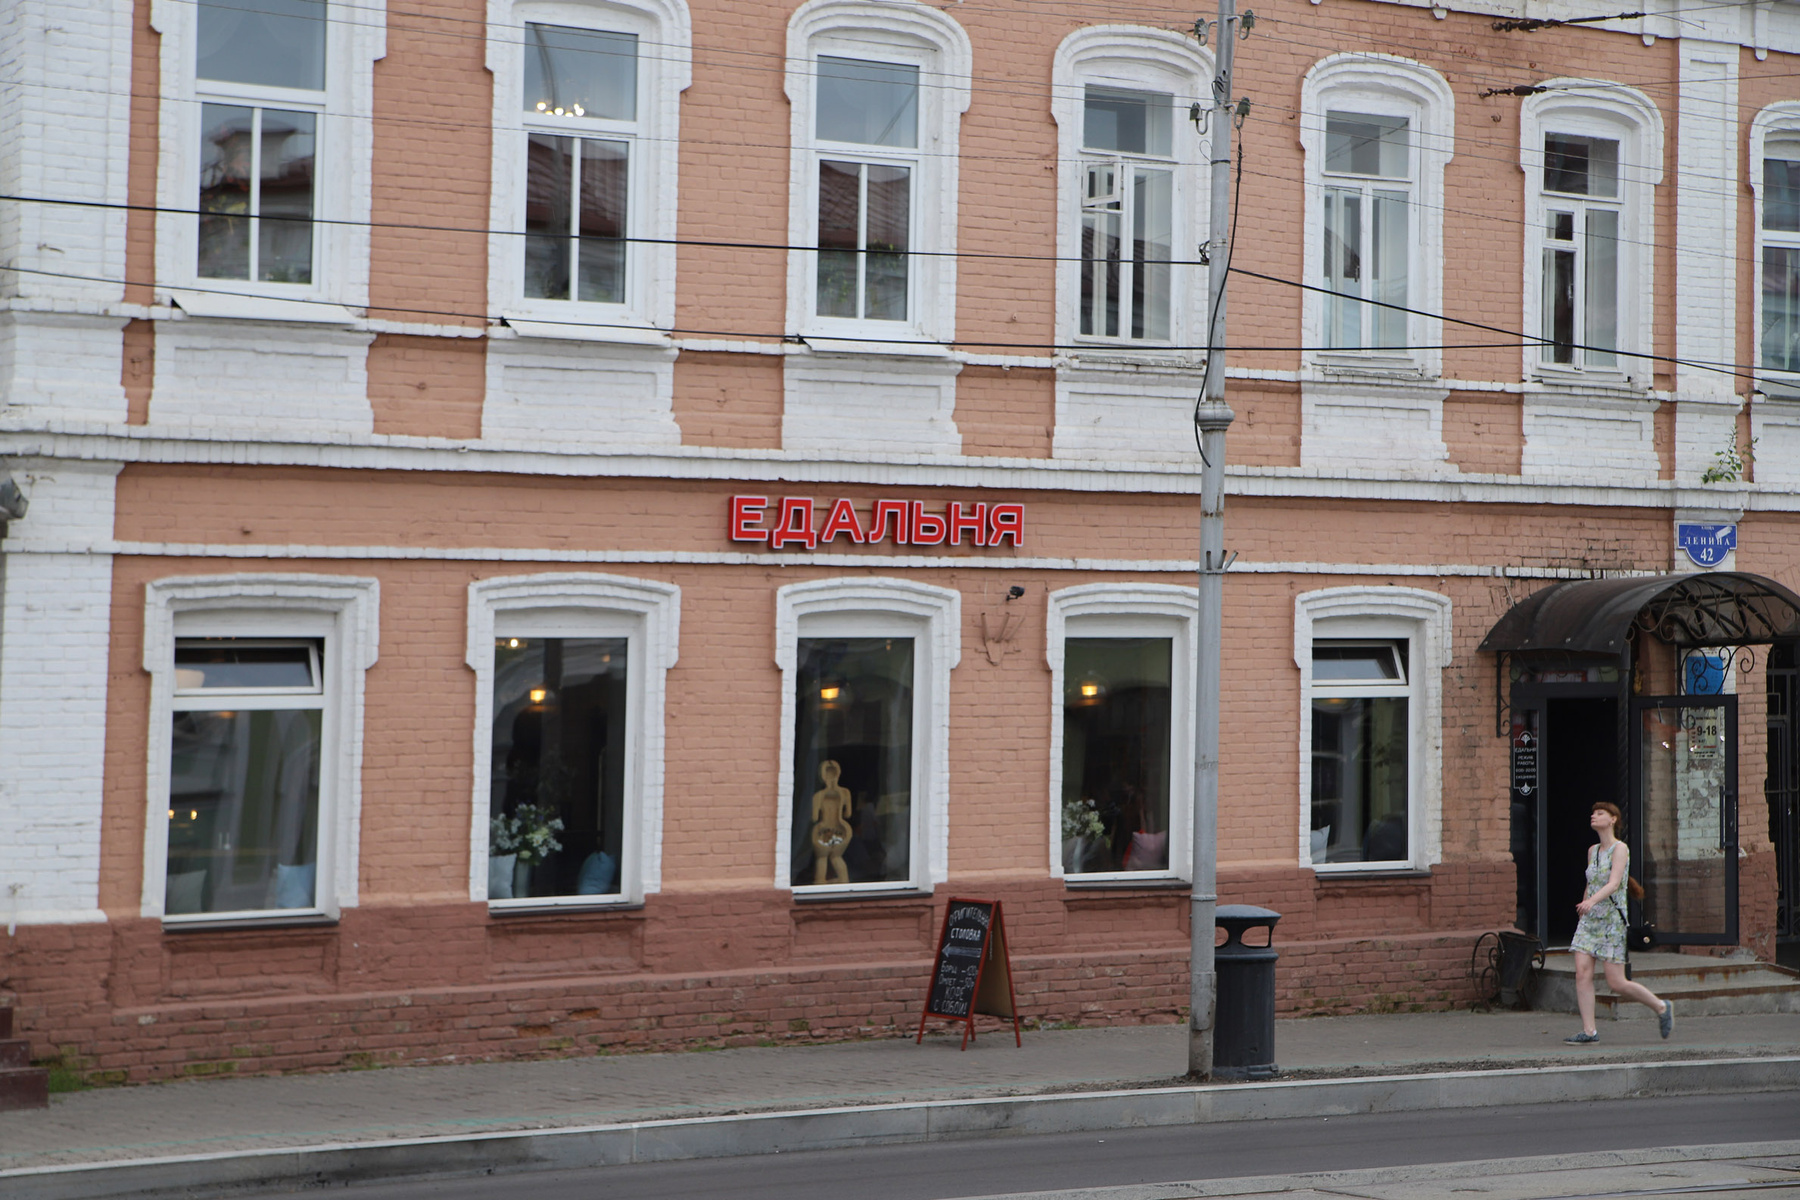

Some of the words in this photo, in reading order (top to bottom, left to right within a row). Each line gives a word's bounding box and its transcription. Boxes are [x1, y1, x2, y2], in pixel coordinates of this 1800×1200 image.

[729, 495, 1025, 549] ЕДАЛЬНЯ
[1685, 536, 1730, 546] ЛЕНИНА
[1700, 547, 1714, 562] 42
[1696, 725, 1717, 736] 9-18
